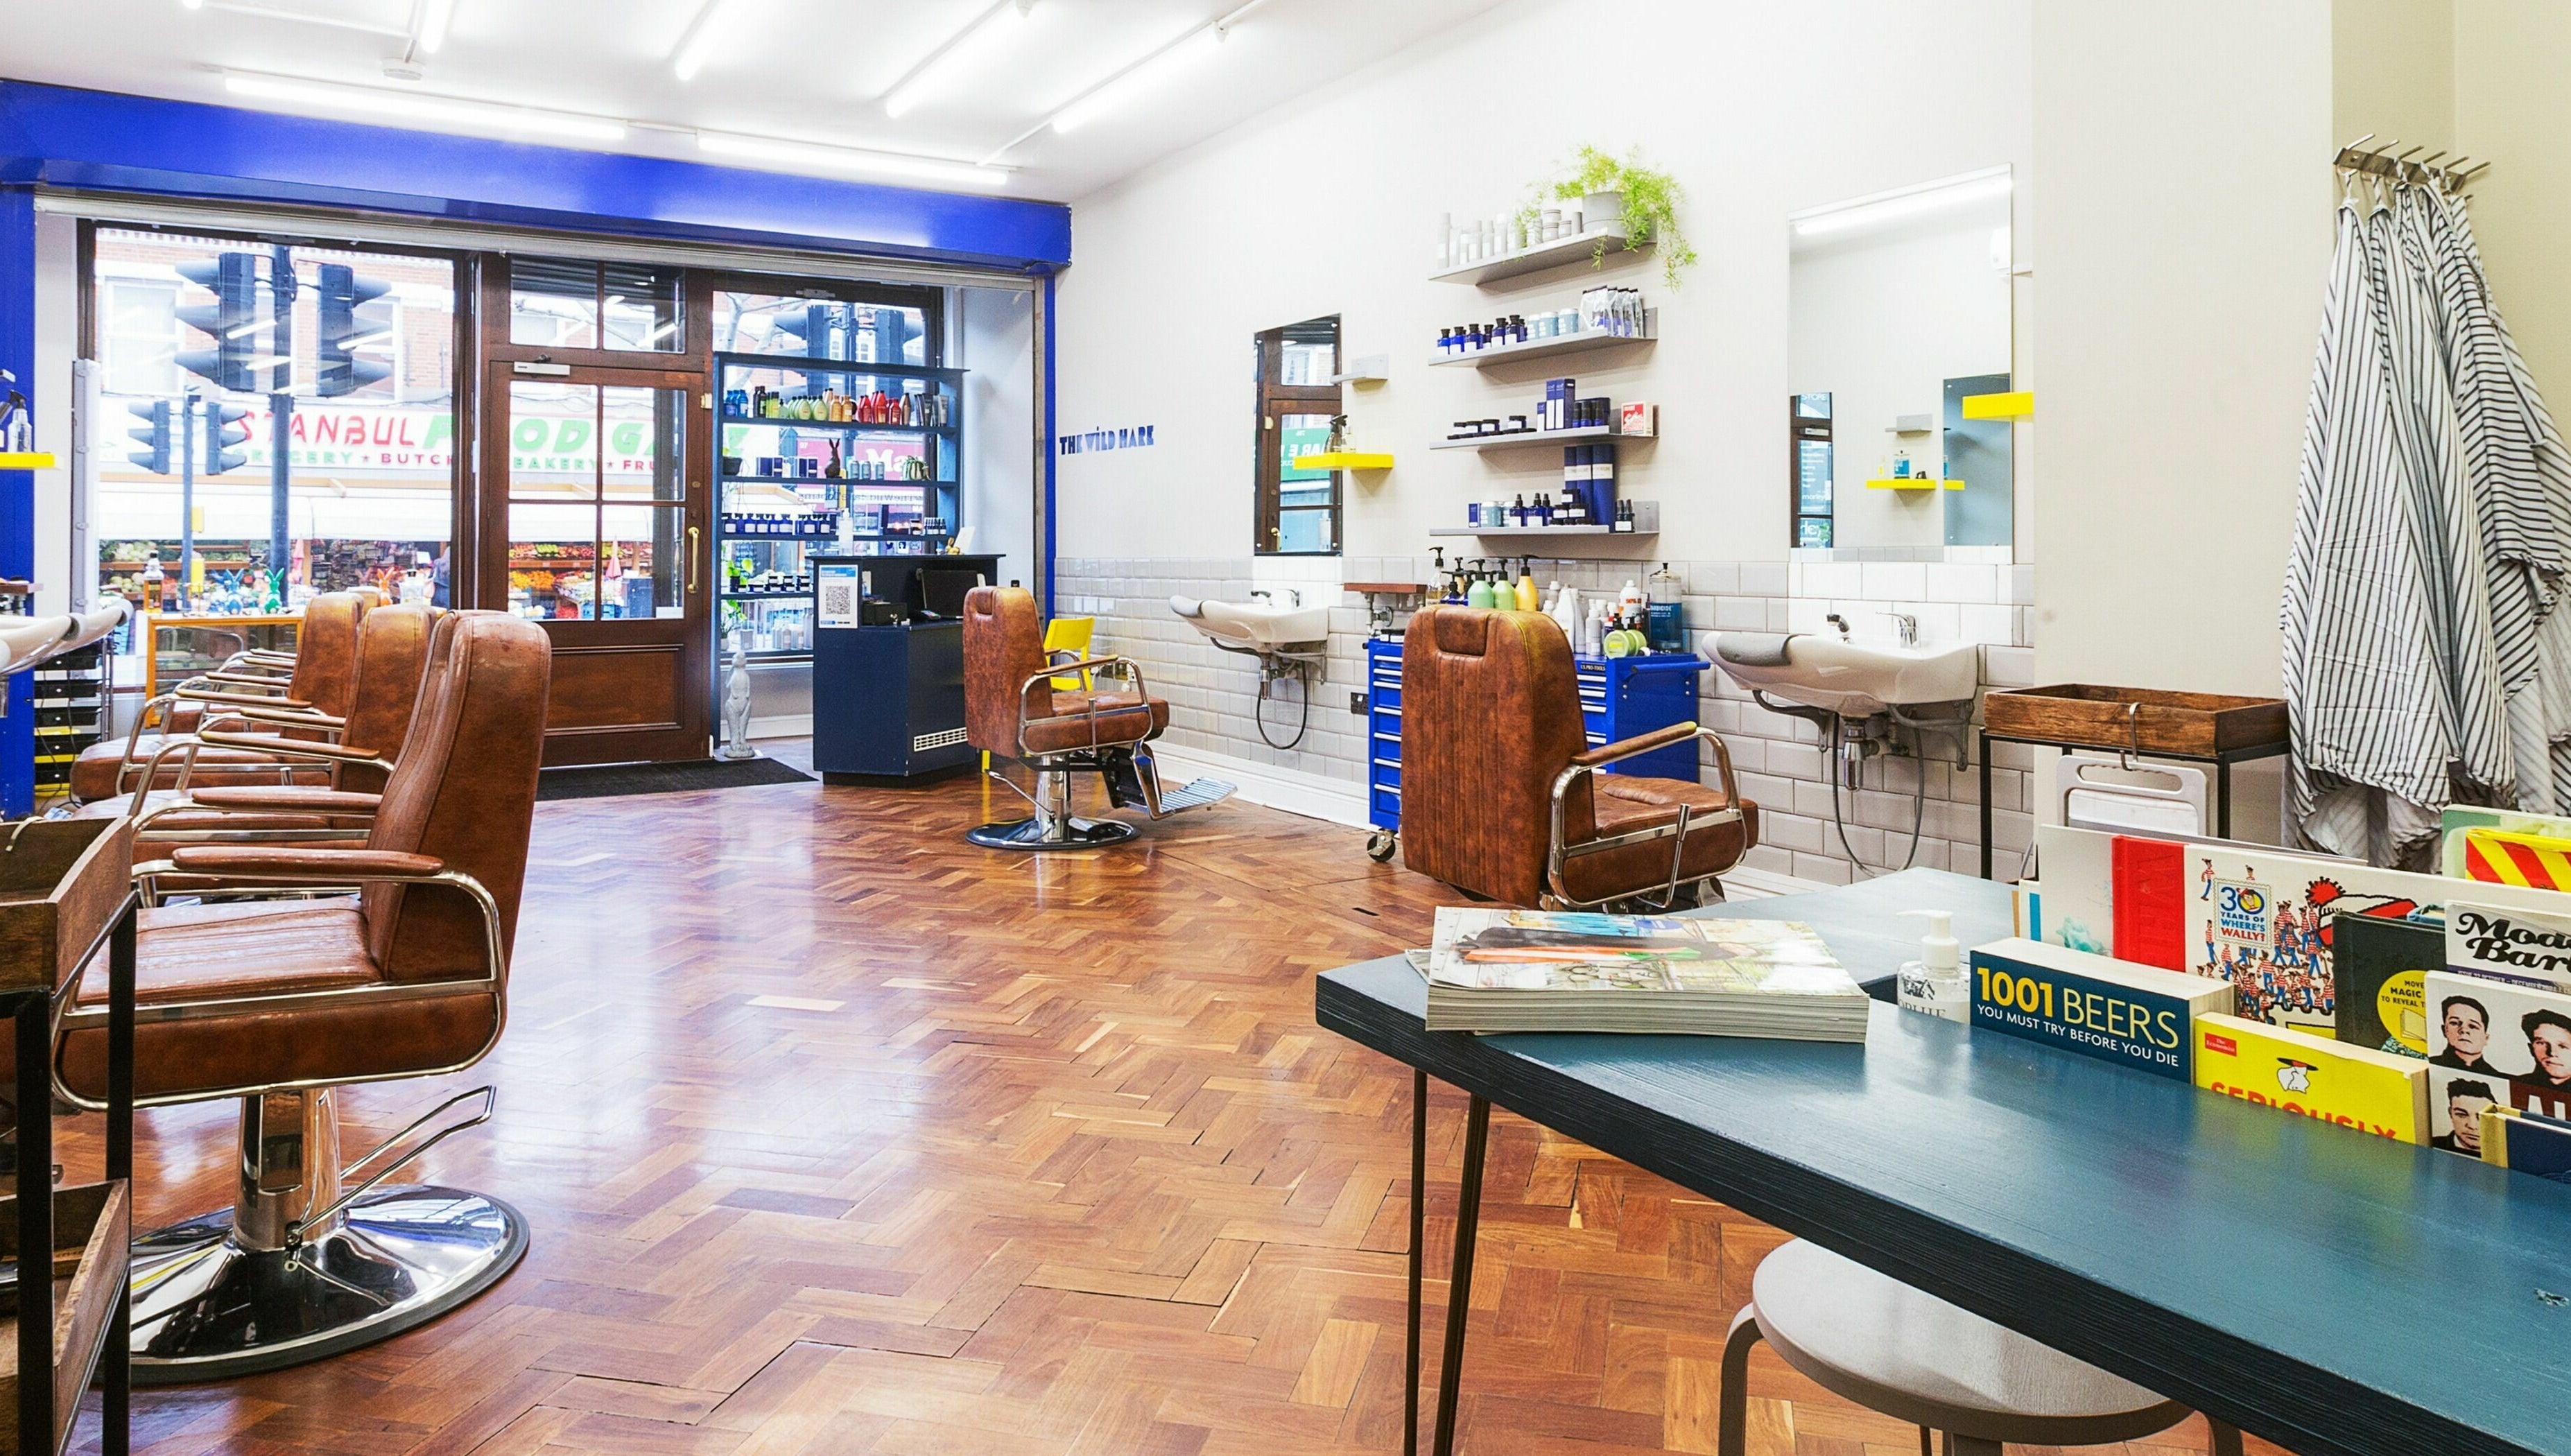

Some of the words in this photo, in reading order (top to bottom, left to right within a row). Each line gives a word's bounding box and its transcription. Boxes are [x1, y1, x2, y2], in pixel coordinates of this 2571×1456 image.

[221, 412, 415, 446] SANBUL
[1059, 434, 1083, 455] THE
[1119, 425, 1154, 449] HARE
[232, 449, 353, 465] RCERY
[2220, 886, 2265, 915] 30
[2220, 910, 2250, 921] YEARS
[2220, 918, 2266, 932] WHERE'S
[2220, 927, 2266, 942] WALLY?
[2455, 912, 2571, 949] Mod
[2466, 936, 2571, 972] Bar
[2390, 987, 2422, 998] MAGIC
[2404, 980, 2425, 989] MOVE
[1977, 967, 2053, 1018] 1001
[2063, 987, 2179, 1049] BEERS
[2392, 997, 2418, 1007] REVEAL
[1977, 1004, 2002, 1020] YOU
[2007, 1012, 2040, 1030] MUST
[2043, 1021, 2066, 1037] TRY
[2070, 1029, 2118, 1051] BEFORE
[2121, 1042, 2152, 1059] YOU
[2156, 1050, 2179, 1067] DIE
